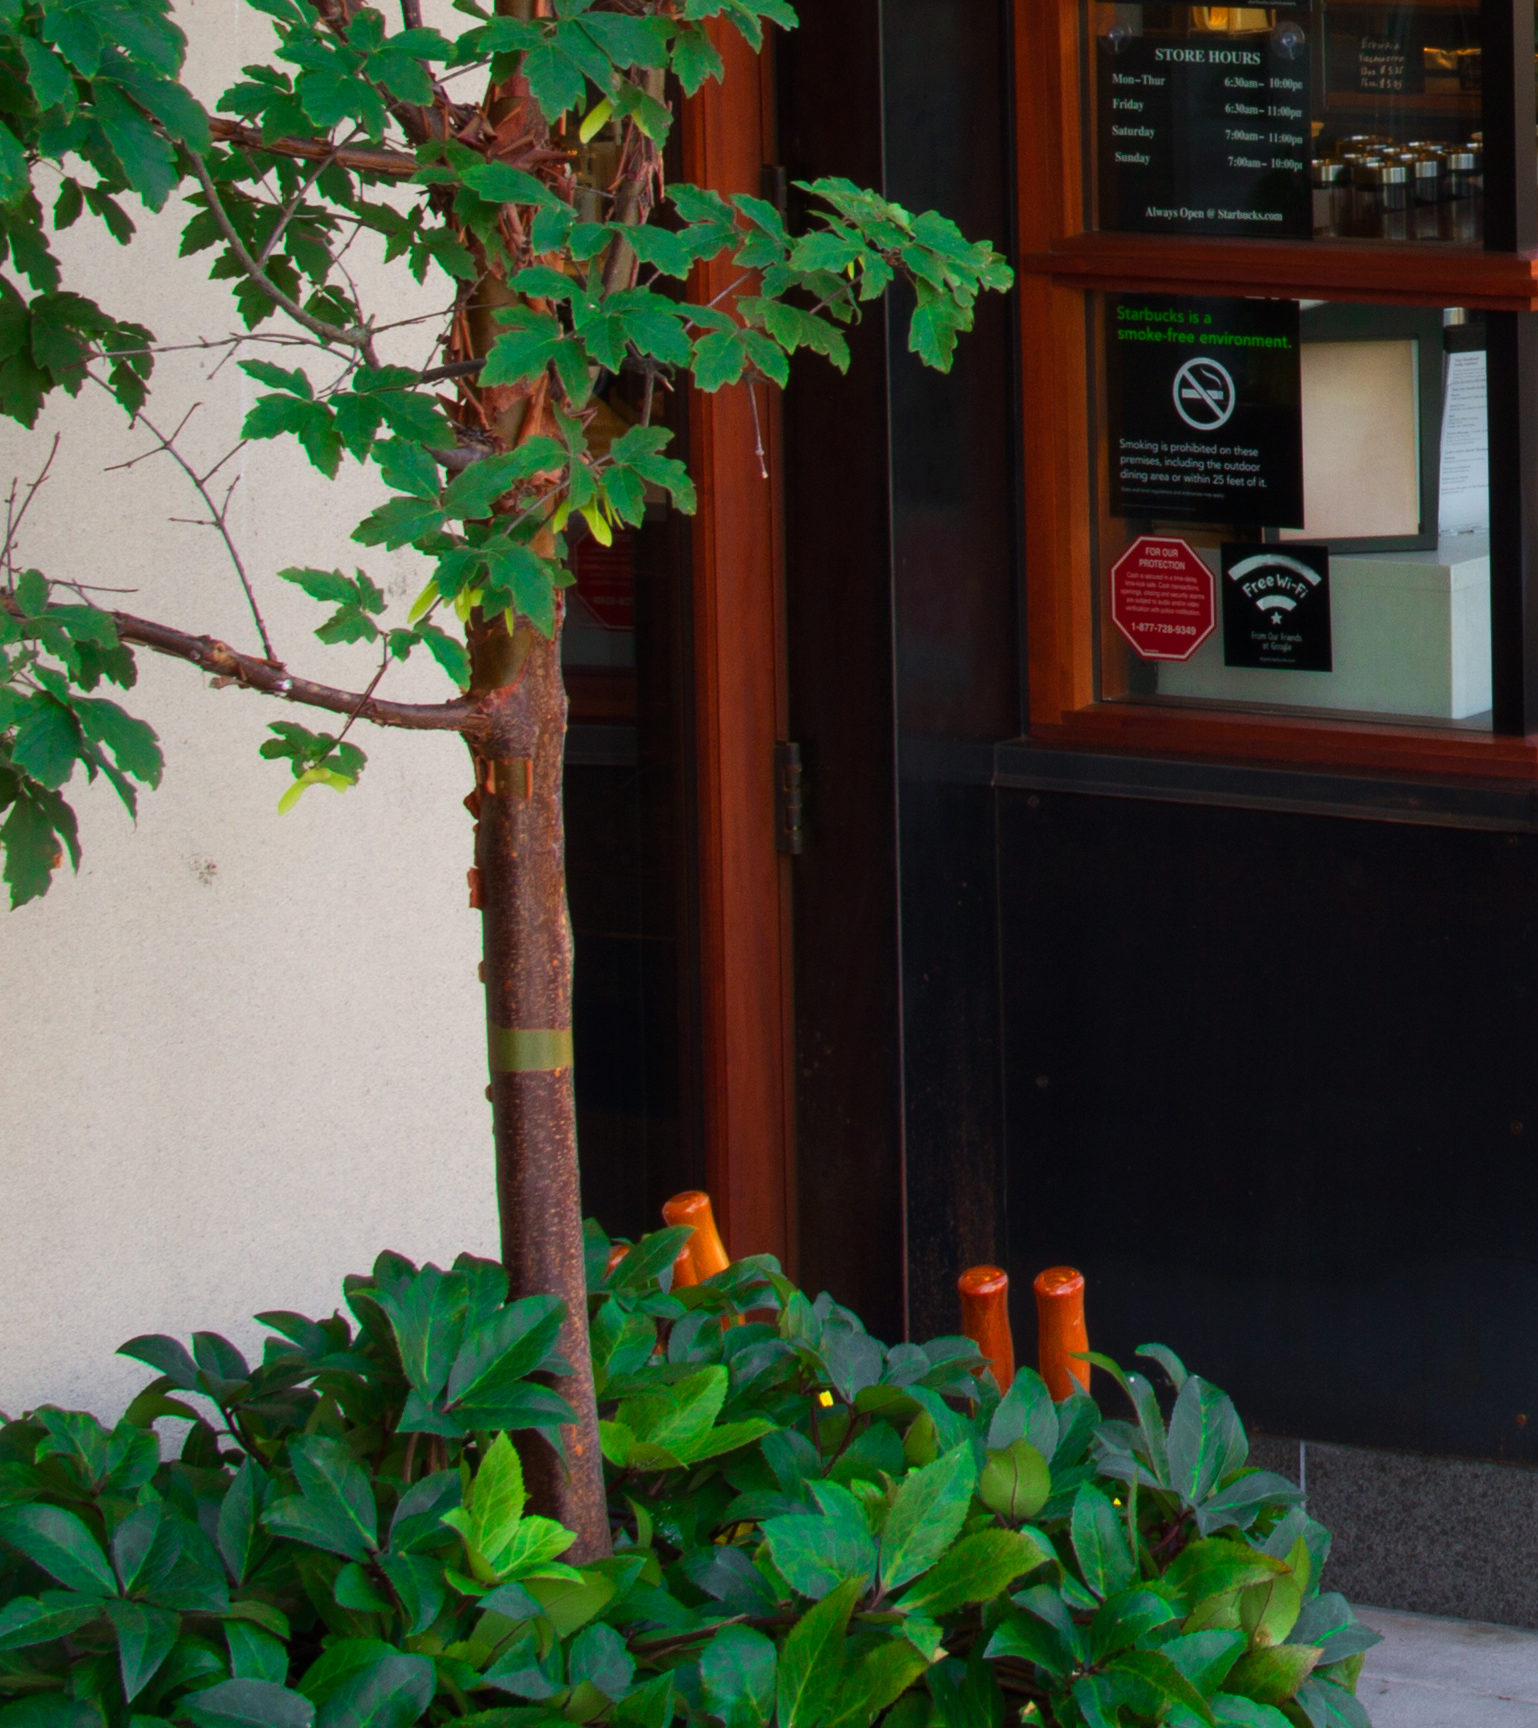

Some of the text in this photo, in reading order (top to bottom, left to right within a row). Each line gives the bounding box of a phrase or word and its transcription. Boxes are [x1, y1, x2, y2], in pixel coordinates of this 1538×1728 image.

[1155, 48, 1262, 65] STORE HOURS
[1113, 98, 1145, 112] Friday
[1112, 126, 1156, 140] Saturday
[1115, 152, 1151, 166] Sunday
[1146, 207, 1178, 220] Always
[1180, 208, 1204, 220] Open
[1217, 209, 1284, 222] Starbucks.com
[1117, 306, 1213, 324] Starbucks is a
[1117, 327, 1293, 350] smoke-free environment.
[1119, 438, 1259, 457] Smoking is prohibited on these
[1120, 456, 1261, 473] premises, including the outdoor
[1120, 470, 1148, 483] dining
[1150, 474, 1170, 482] area
[1184, 474, 1211, 484] within
[1212, 475, 1225, 485] 25
[1226, 475, 1245, 487] feet
[1246, 476, 1257, 488] of
[1258, 477, 1268, 488] it.
[1145, 547, 1178, 559] FOR OUR
[1139, 559, 1186, 570] PROTECTION
[1242, 573, 1309, 599] Free Wi-Fi
[1251, 631, 1302, 642] From Our Friends
[1263, 642, 1292, 653] at Google
